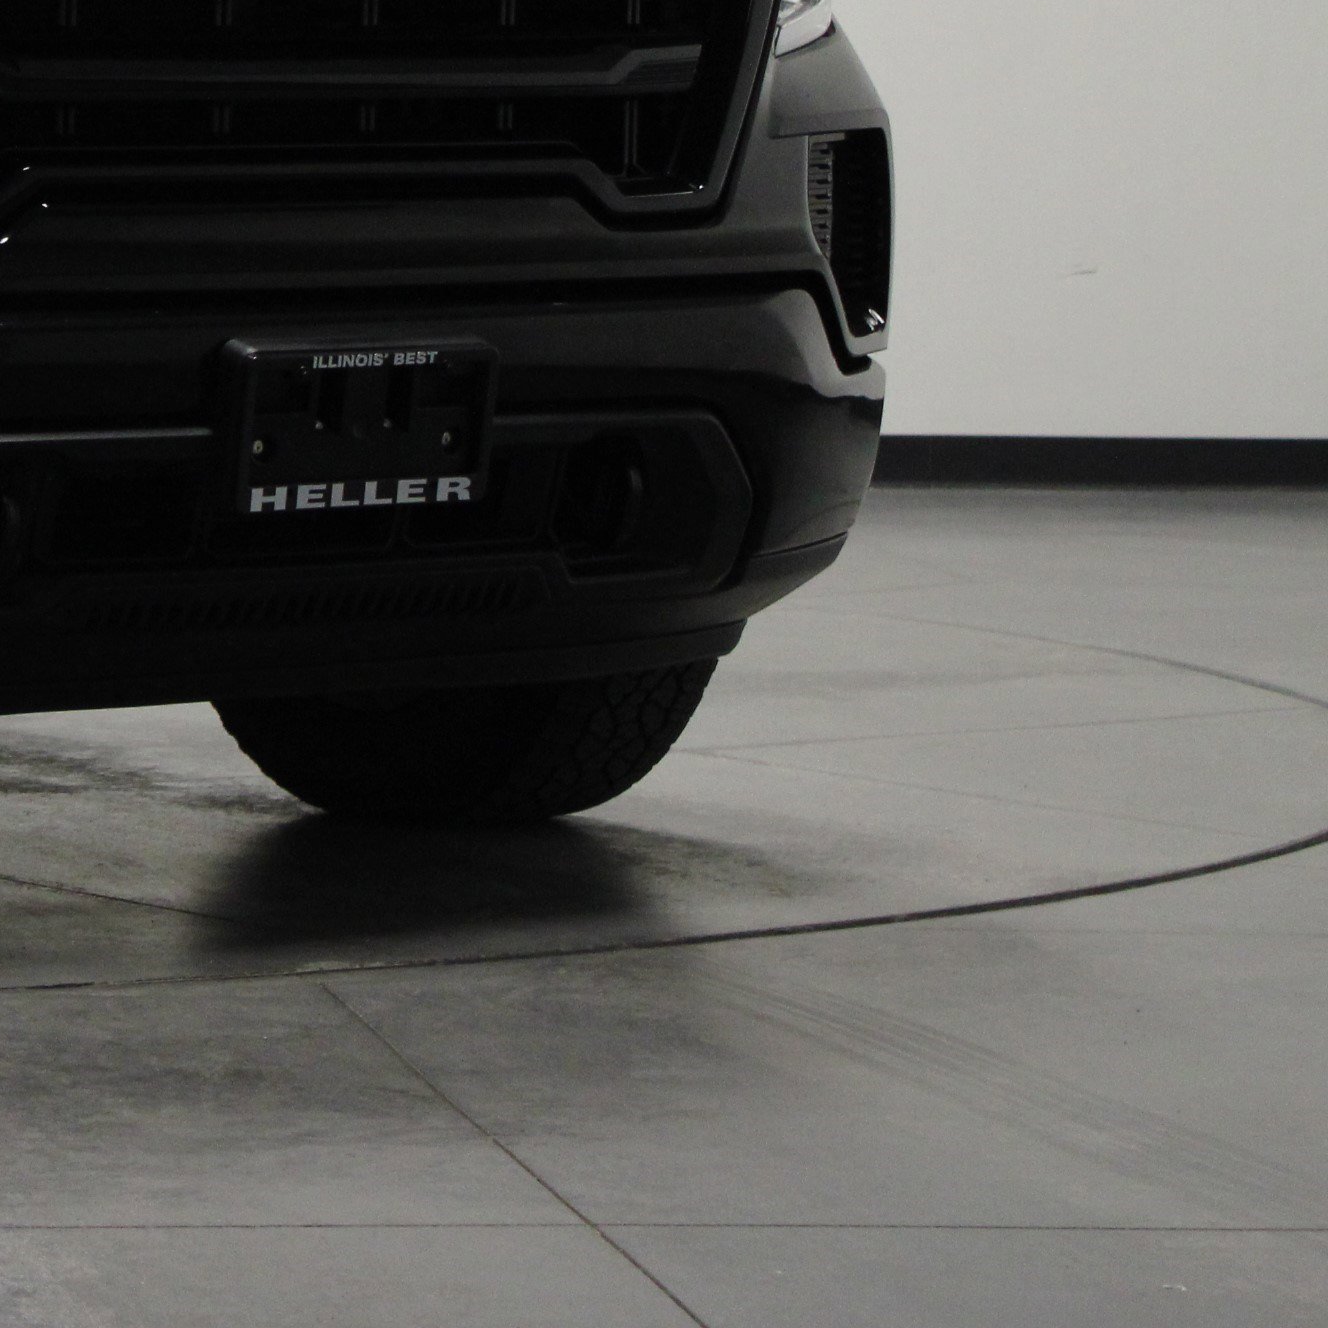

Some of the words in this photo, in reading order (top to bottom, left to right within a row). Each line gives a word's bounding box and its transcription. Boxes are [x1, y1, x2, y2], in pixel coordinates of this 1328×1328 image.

[313, 352, 389, 369] ILLINOIS'
[394, 351, 438, 366] BEST
[250, 476, 472, 512] HELLER
